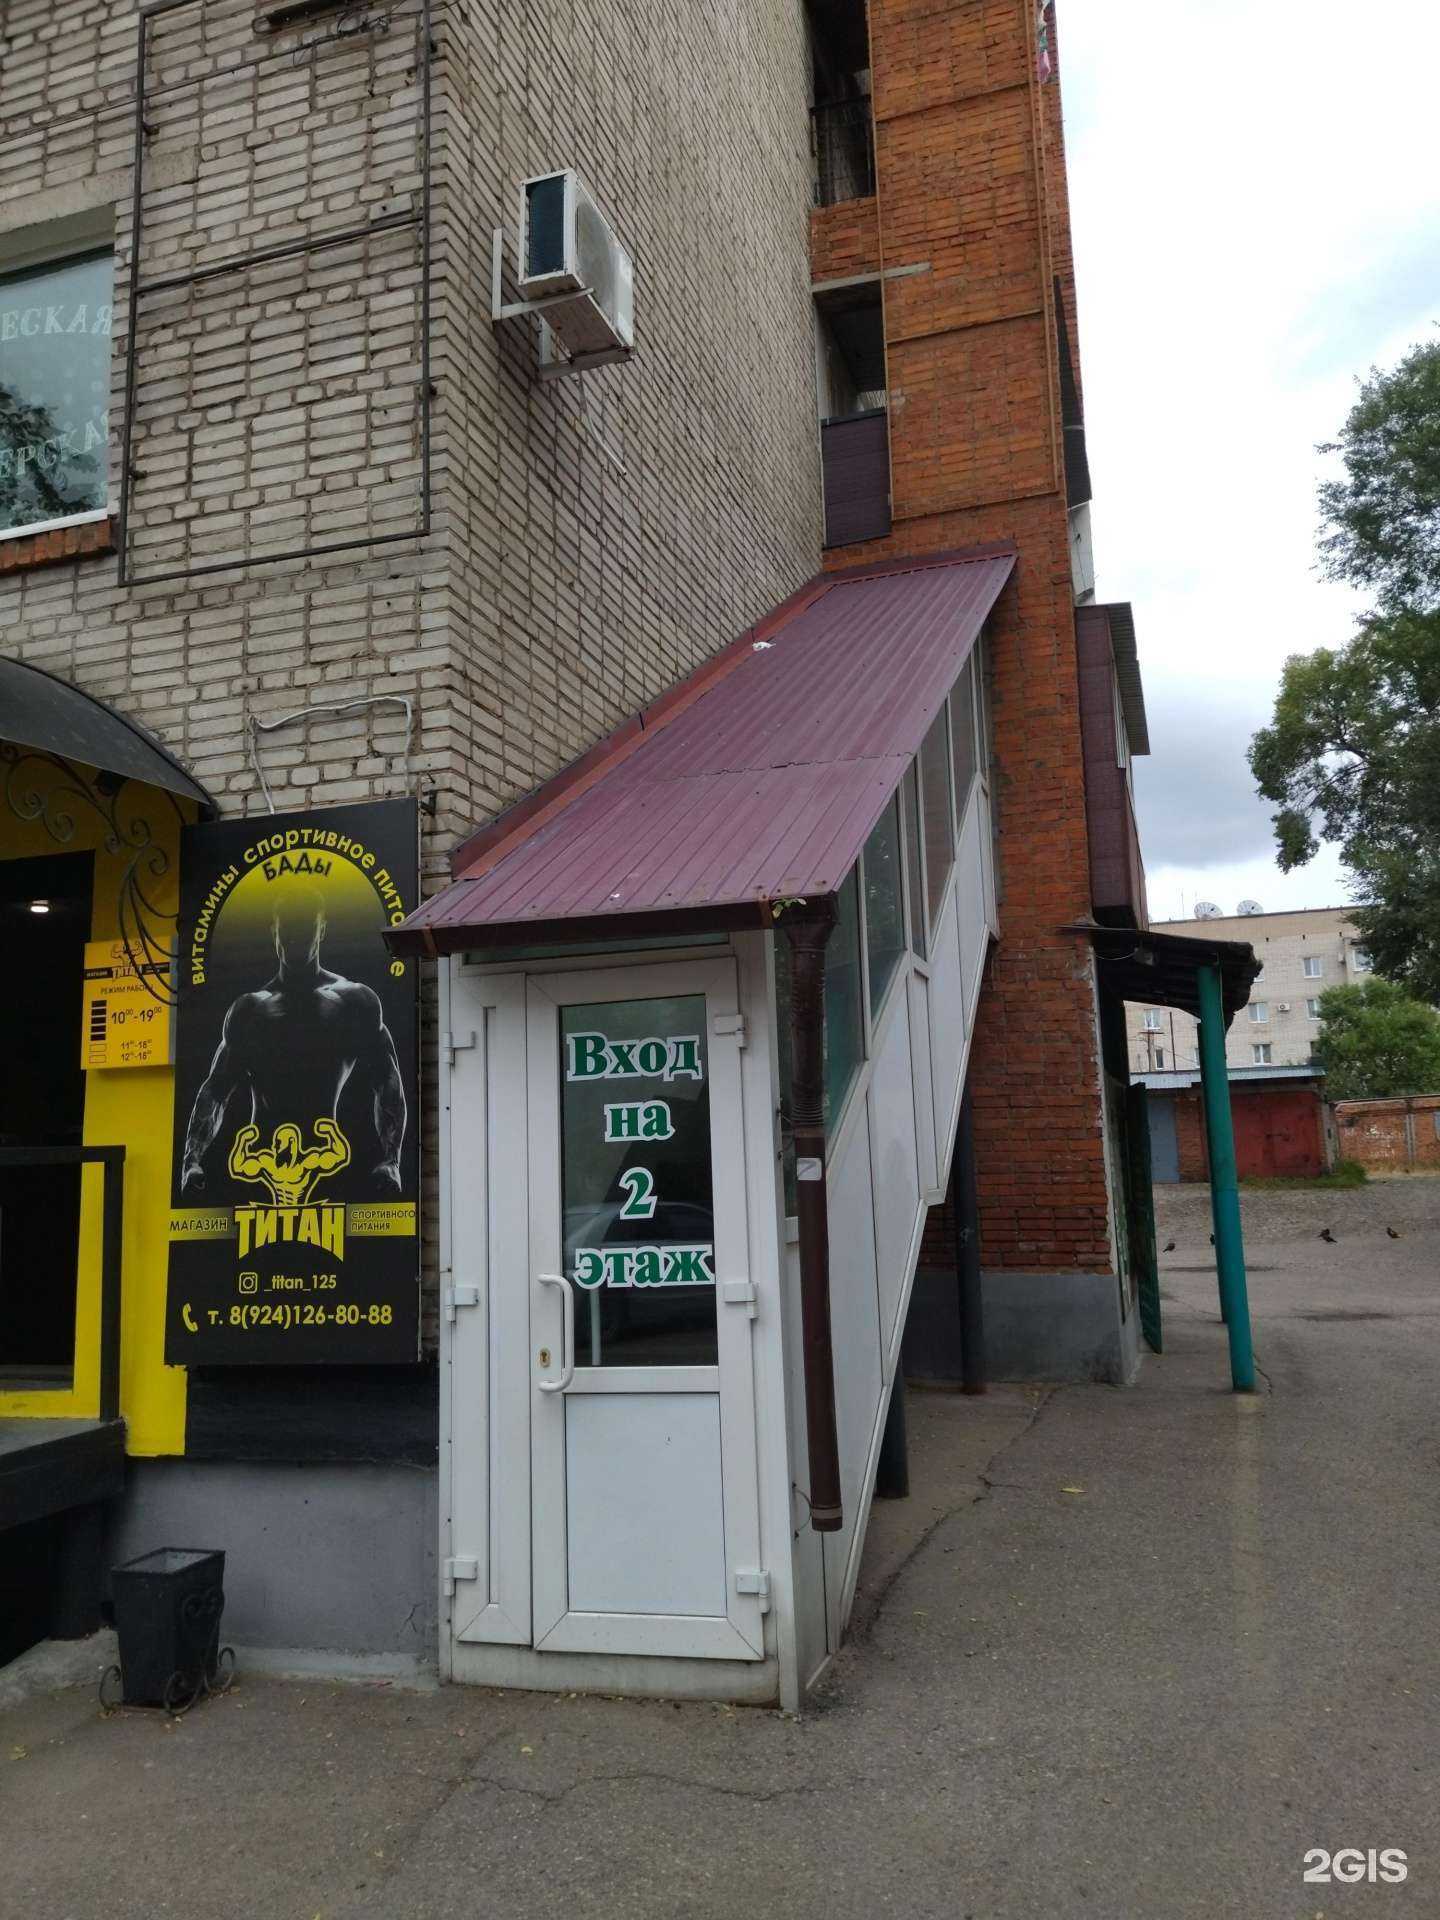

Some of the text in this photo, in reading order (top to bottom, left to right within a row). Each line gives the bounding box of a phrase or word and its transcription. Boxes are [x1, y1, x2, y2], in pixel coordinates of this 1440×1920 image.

[192, 829, 408, 985] витамины спортивное питае
[567, 1032, 702, 1081] Вход
[604, 1100, 675, 1142] на
[351, 1209, 415, 1220] СПОРТИВНОГО
[619, 1167, 657, 1220] 2
[169, 1217, 228, 1232] МАГАЗИН
[235, 1206, 345, 1262] ТИТАН
[351, 1222, 391, 1233] ПИТАНИЯ
[263, 1275, 337, 1292] _titan_125
[574, 1244, 715, 1289] этаж
[229, 1304, 393, 1329] 8(924)126-80-88
